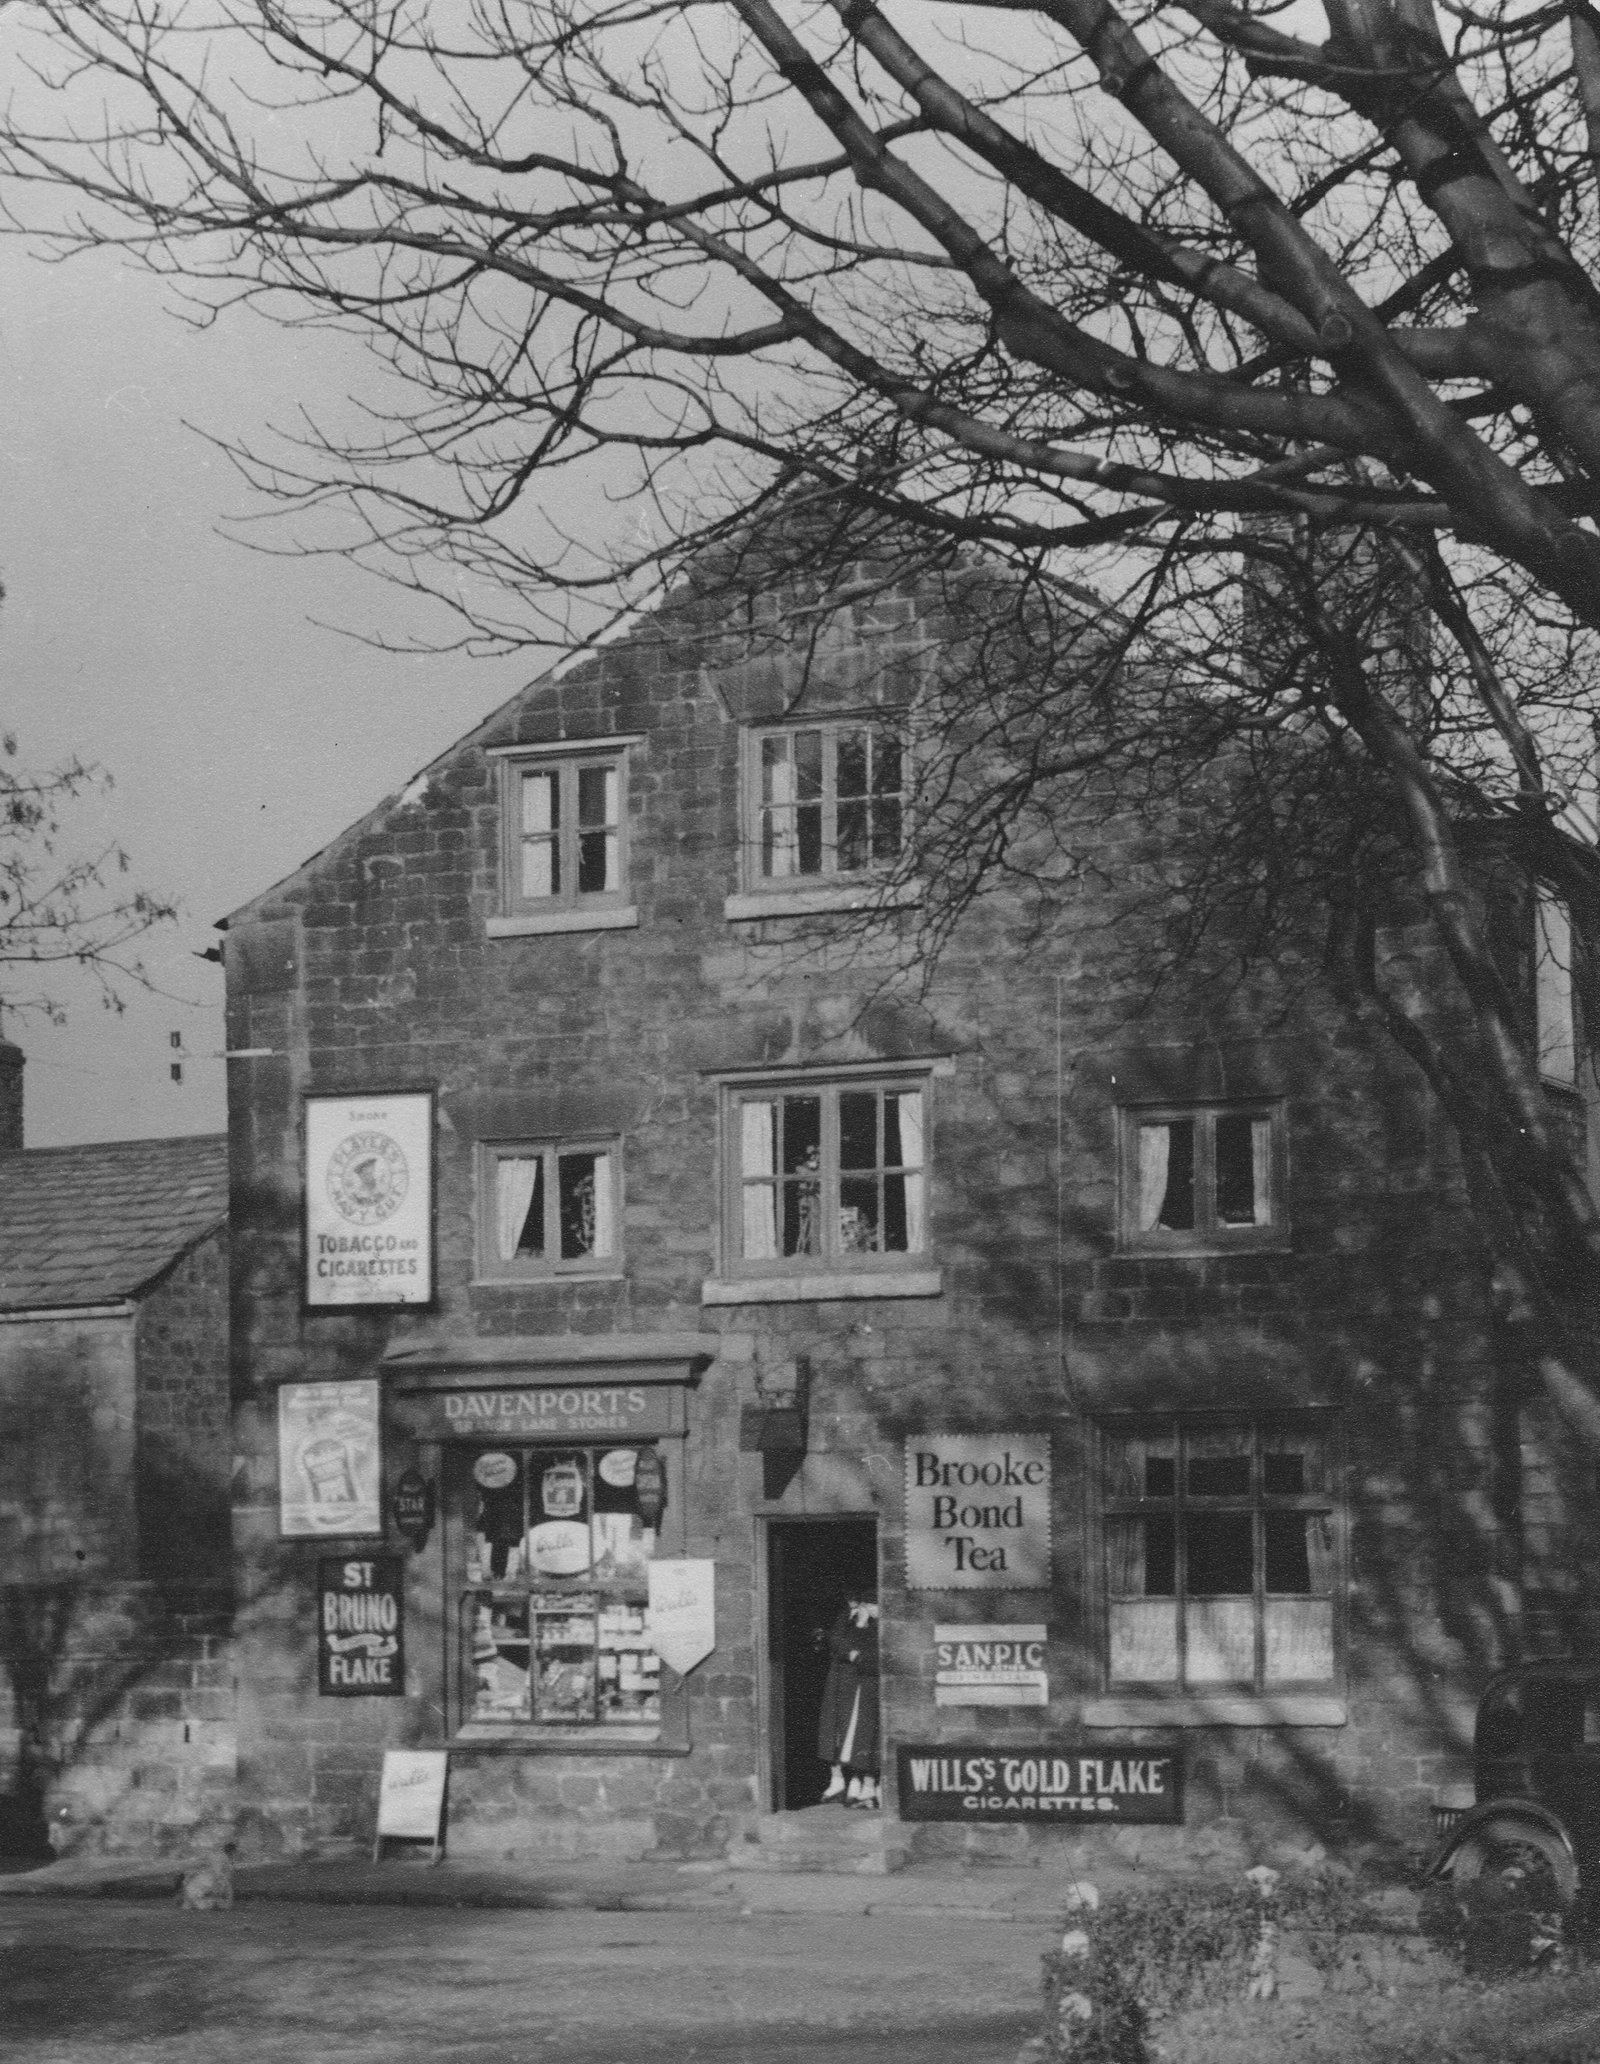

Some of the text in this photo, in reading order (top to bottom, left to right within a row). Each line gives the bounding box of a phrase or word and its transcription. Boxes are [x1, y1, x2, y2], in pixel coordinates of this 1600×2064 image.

[317, 1234, 397, 1253] TOBACCO
[316, 1258, 418, 1278] CIGARETTES
[445, 1388, 647, 1418] DAVENPORTS
[915, 1451, 1044, 1486] Brooke
[932, 1495, 1023, 1528] Bond
[944, 1536, 1009, 1571] Tea
[343, 1562, 375, 1587] ST
[323, 1592, 398, 1631] BRUNO
[329, 1655, 391, 1685] FLAKE
[937, 1643, 1044, 1668] SANPIC
